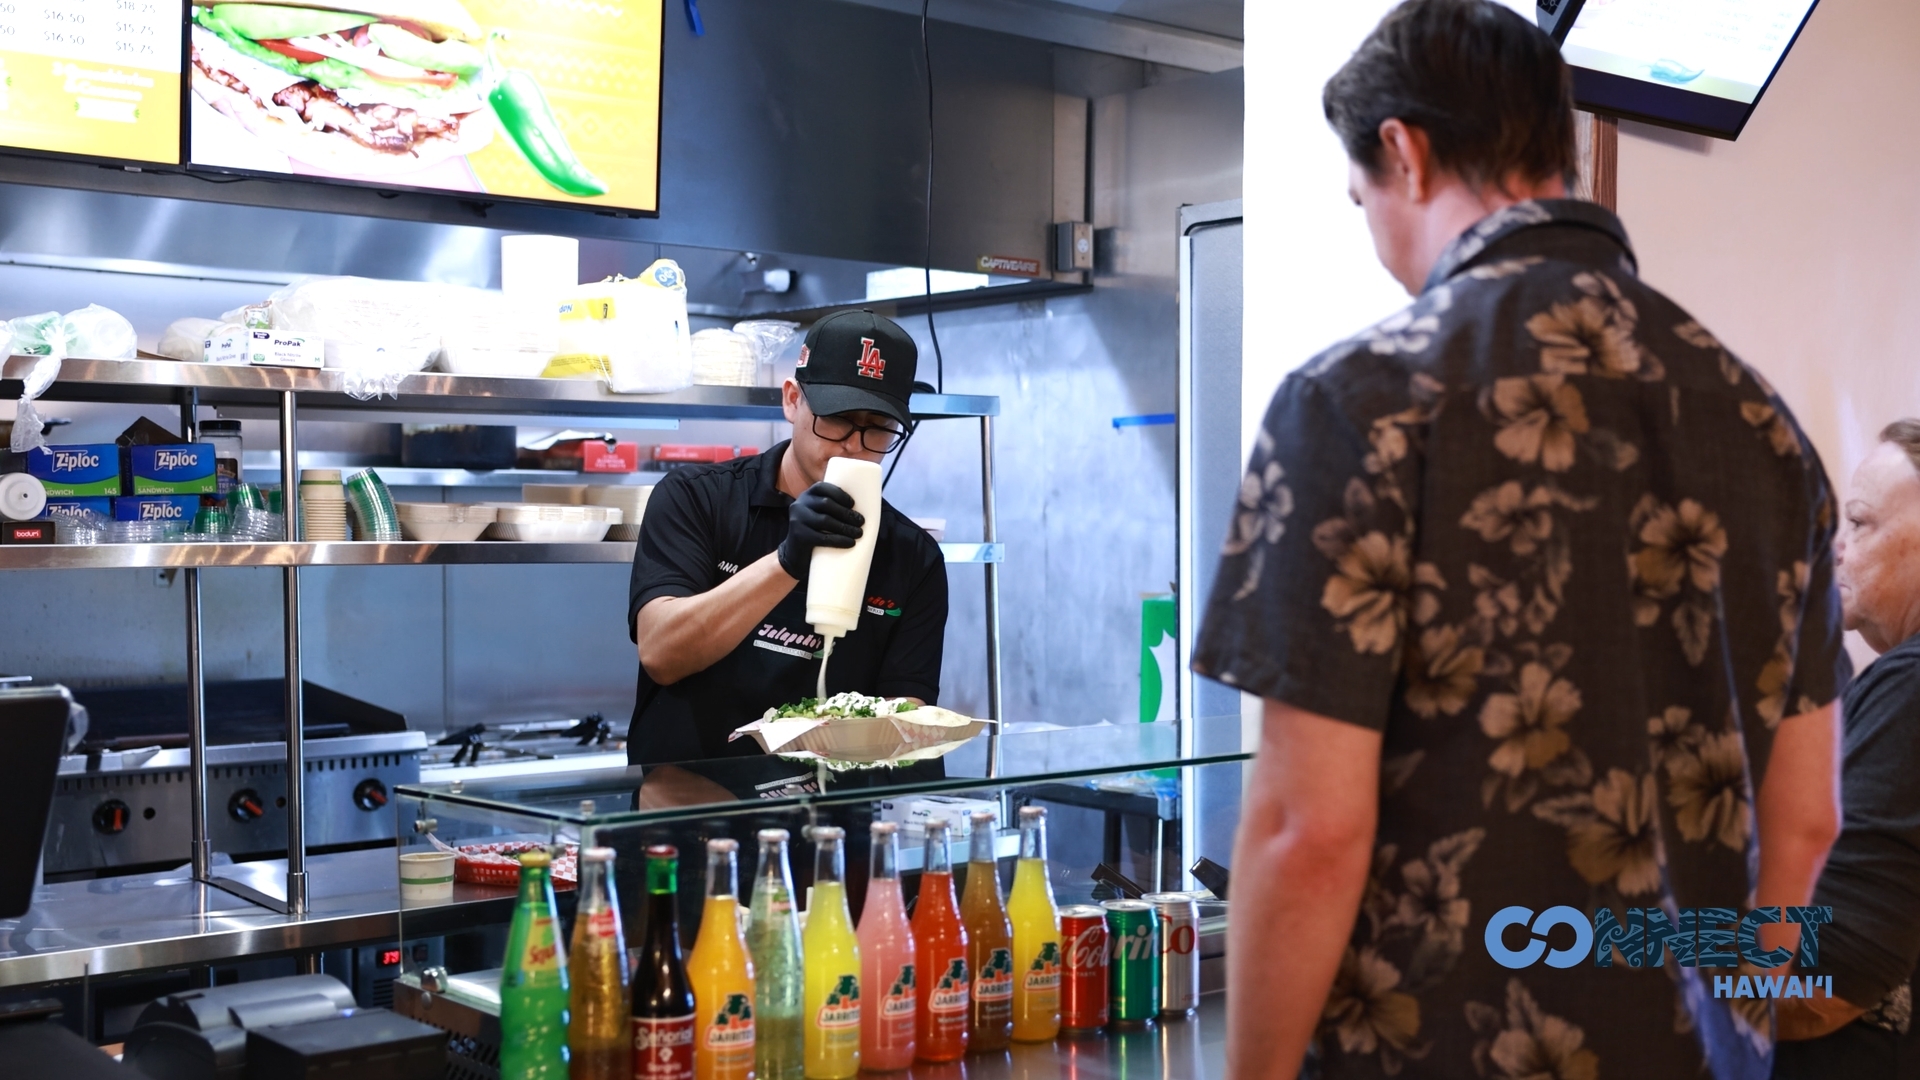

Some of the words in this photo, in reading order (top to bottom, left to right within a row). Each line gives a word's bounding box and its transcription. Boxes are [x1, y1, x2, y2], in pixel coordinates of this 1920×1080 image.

[44, 9, 85, 24] $16.50
[115, 21, 154, 36] $15.75
[44, 31, 85, 46] $16.50
[115, 41, 154, 55] $15.75
[274, 339, 302, 348] ProPak
[857, 336, 886, 380] LA
[56, 449, 100, 472] Ziploc
[157, 449, 198, 470] Ziploc
[46, 488, 74, 496] NDWICH
[104, 487, 118, 495] 145
[201, 485, 214, 493] 145
[142, 503, 183, 521] Ziploc
[978, 982, 1012, 995] JARRIT
[1027, 974, 1060, 987] JARRIT
